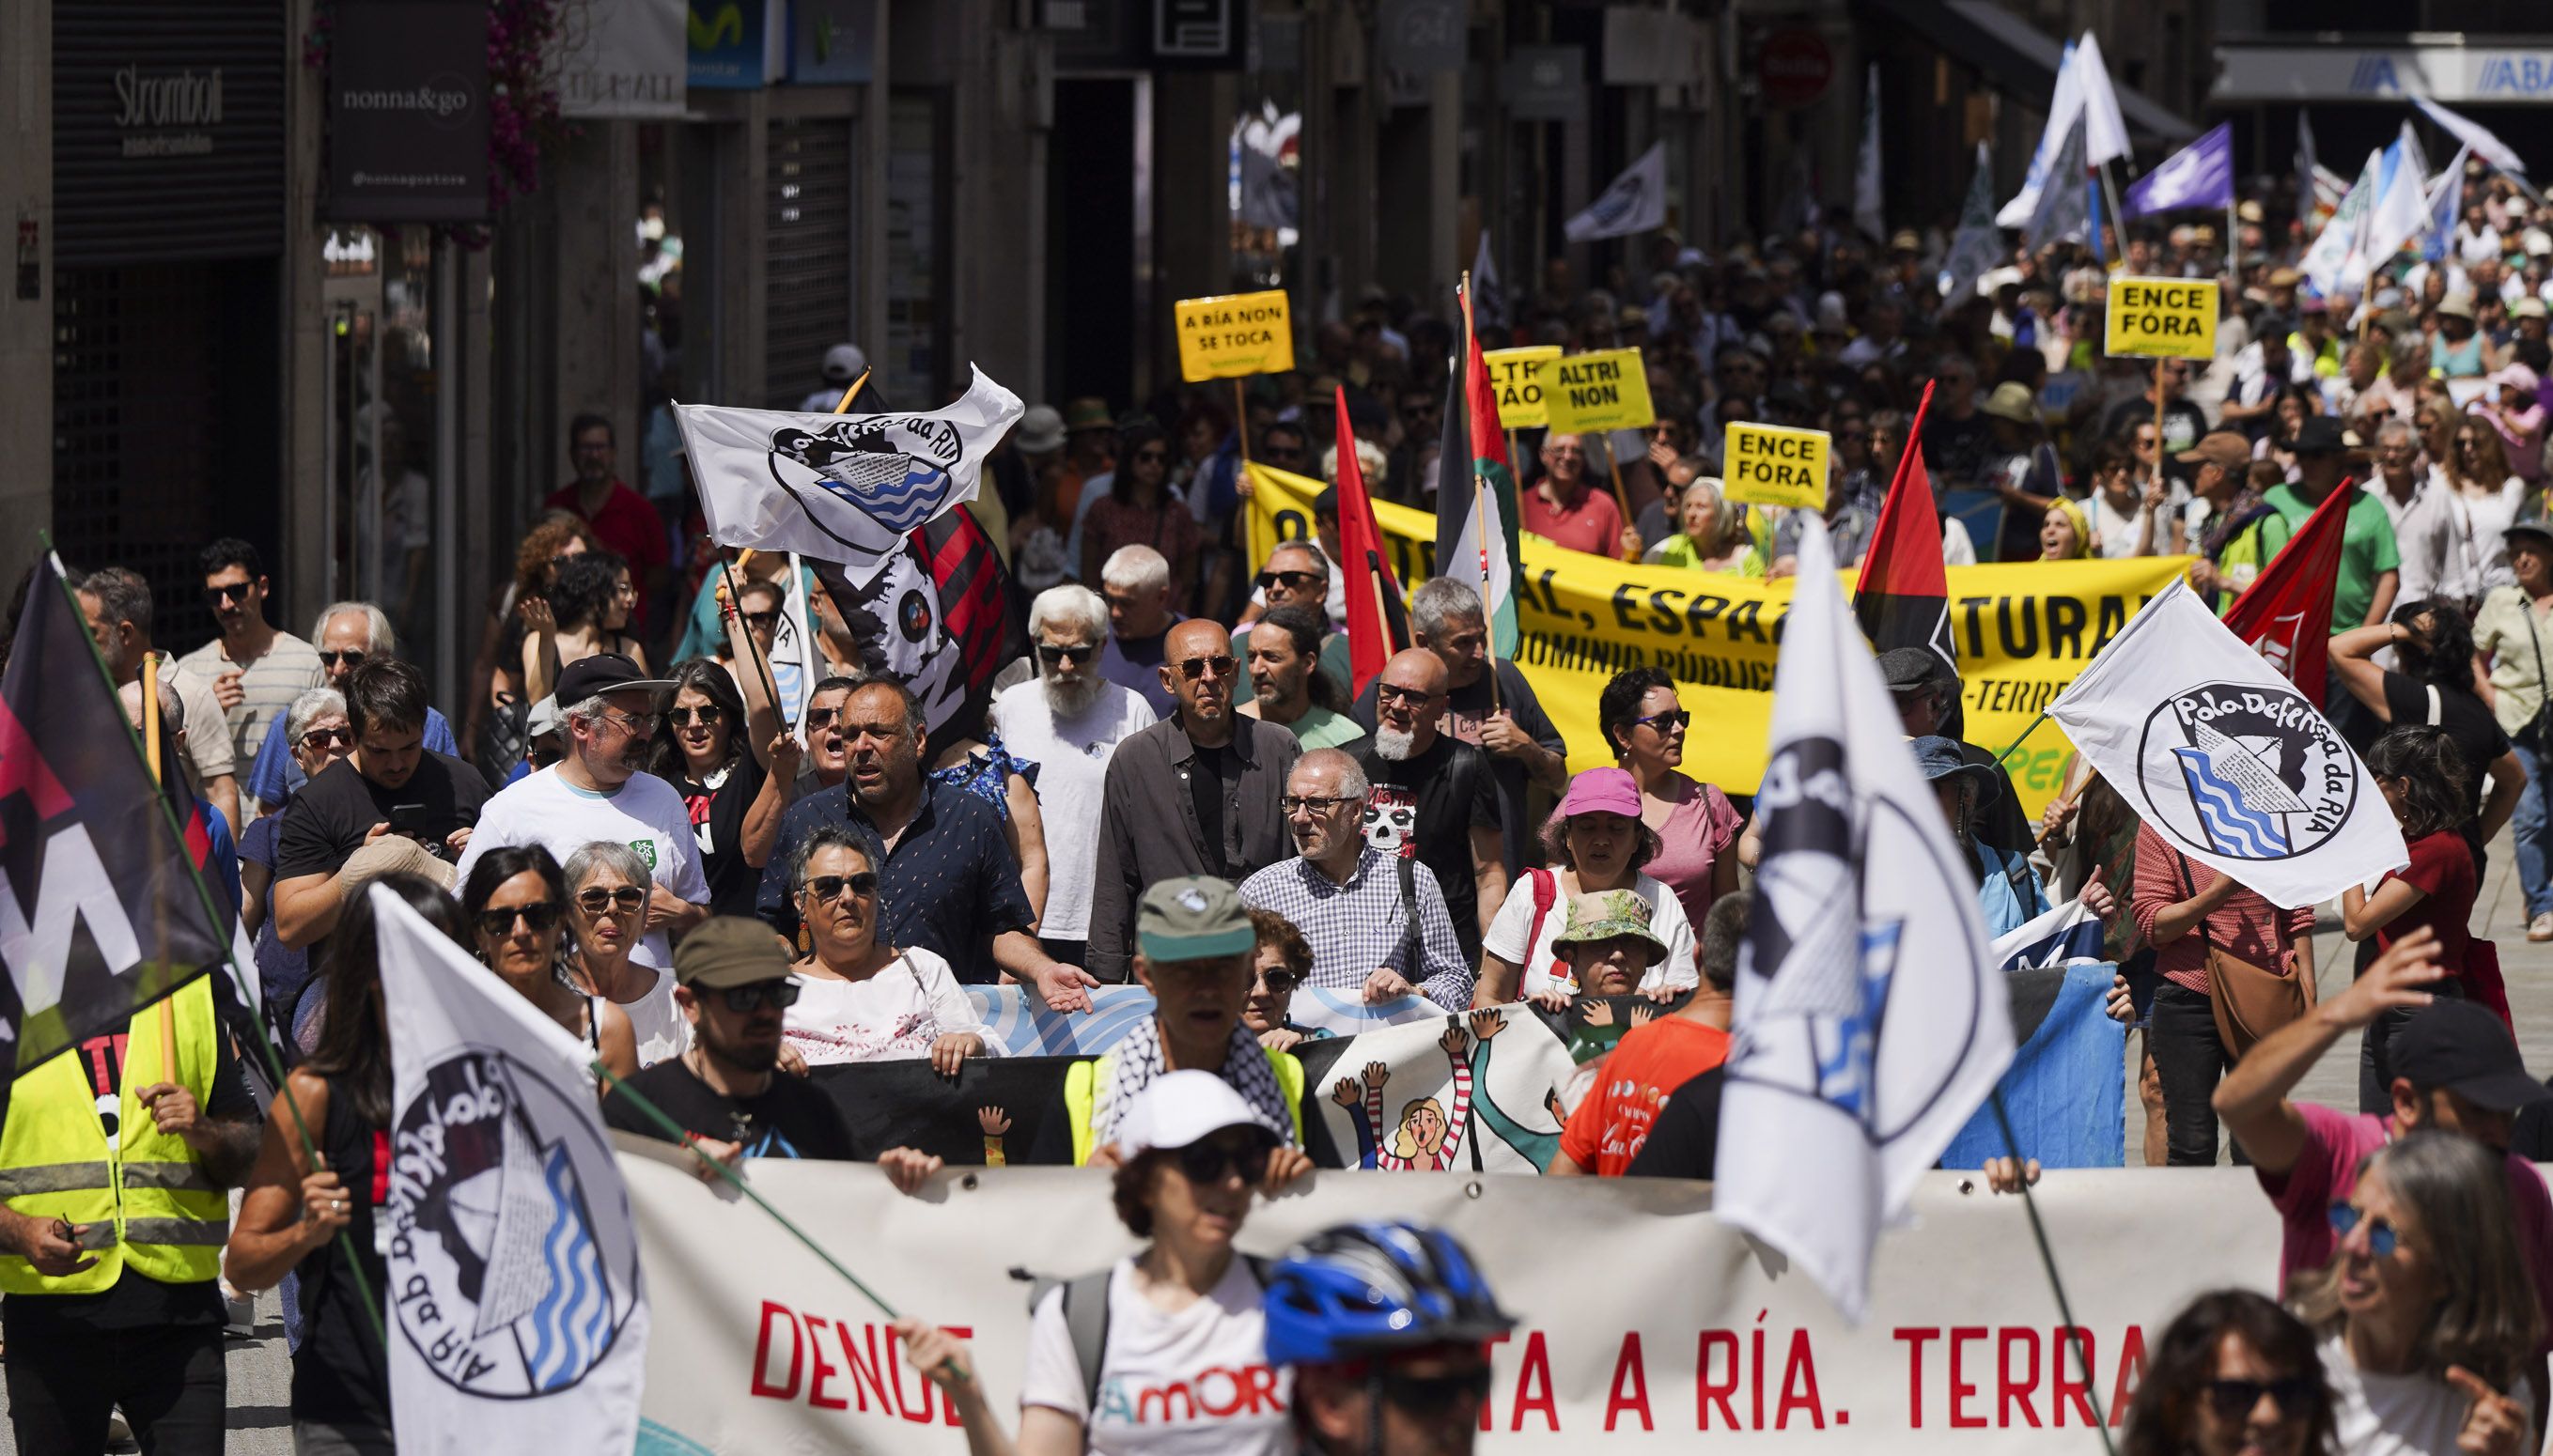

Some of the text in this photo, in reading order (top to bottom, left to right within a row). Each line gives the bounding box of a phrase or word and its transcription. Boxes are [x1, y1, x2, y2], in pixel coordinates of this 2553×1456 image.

[342, 86, 468, 116] nonna&go
[2123, 287, 2203, 310] ENCE
[1185, 306, 1282, 329] A RÍA NON
[2122, 310, 2203, 337] FÓRA
[1198, 330, 1272, 351] SE TOCA
[1558, 360, 1622, 387] ALTRI
[1569, 384, 1620, 409] NON
[1739, 433, 1815, 461] ENCE
[1737, 457, 1814, 488] FÓRA
[2174, 690, 2245, 726] Pola
[2240, 692, 2343, 760] Defensa
[2323, 763, 2352, 796] da
[1603, 1330, 1655, 1433] A
[1695, 1307, 1850, 1433] RÍA.
